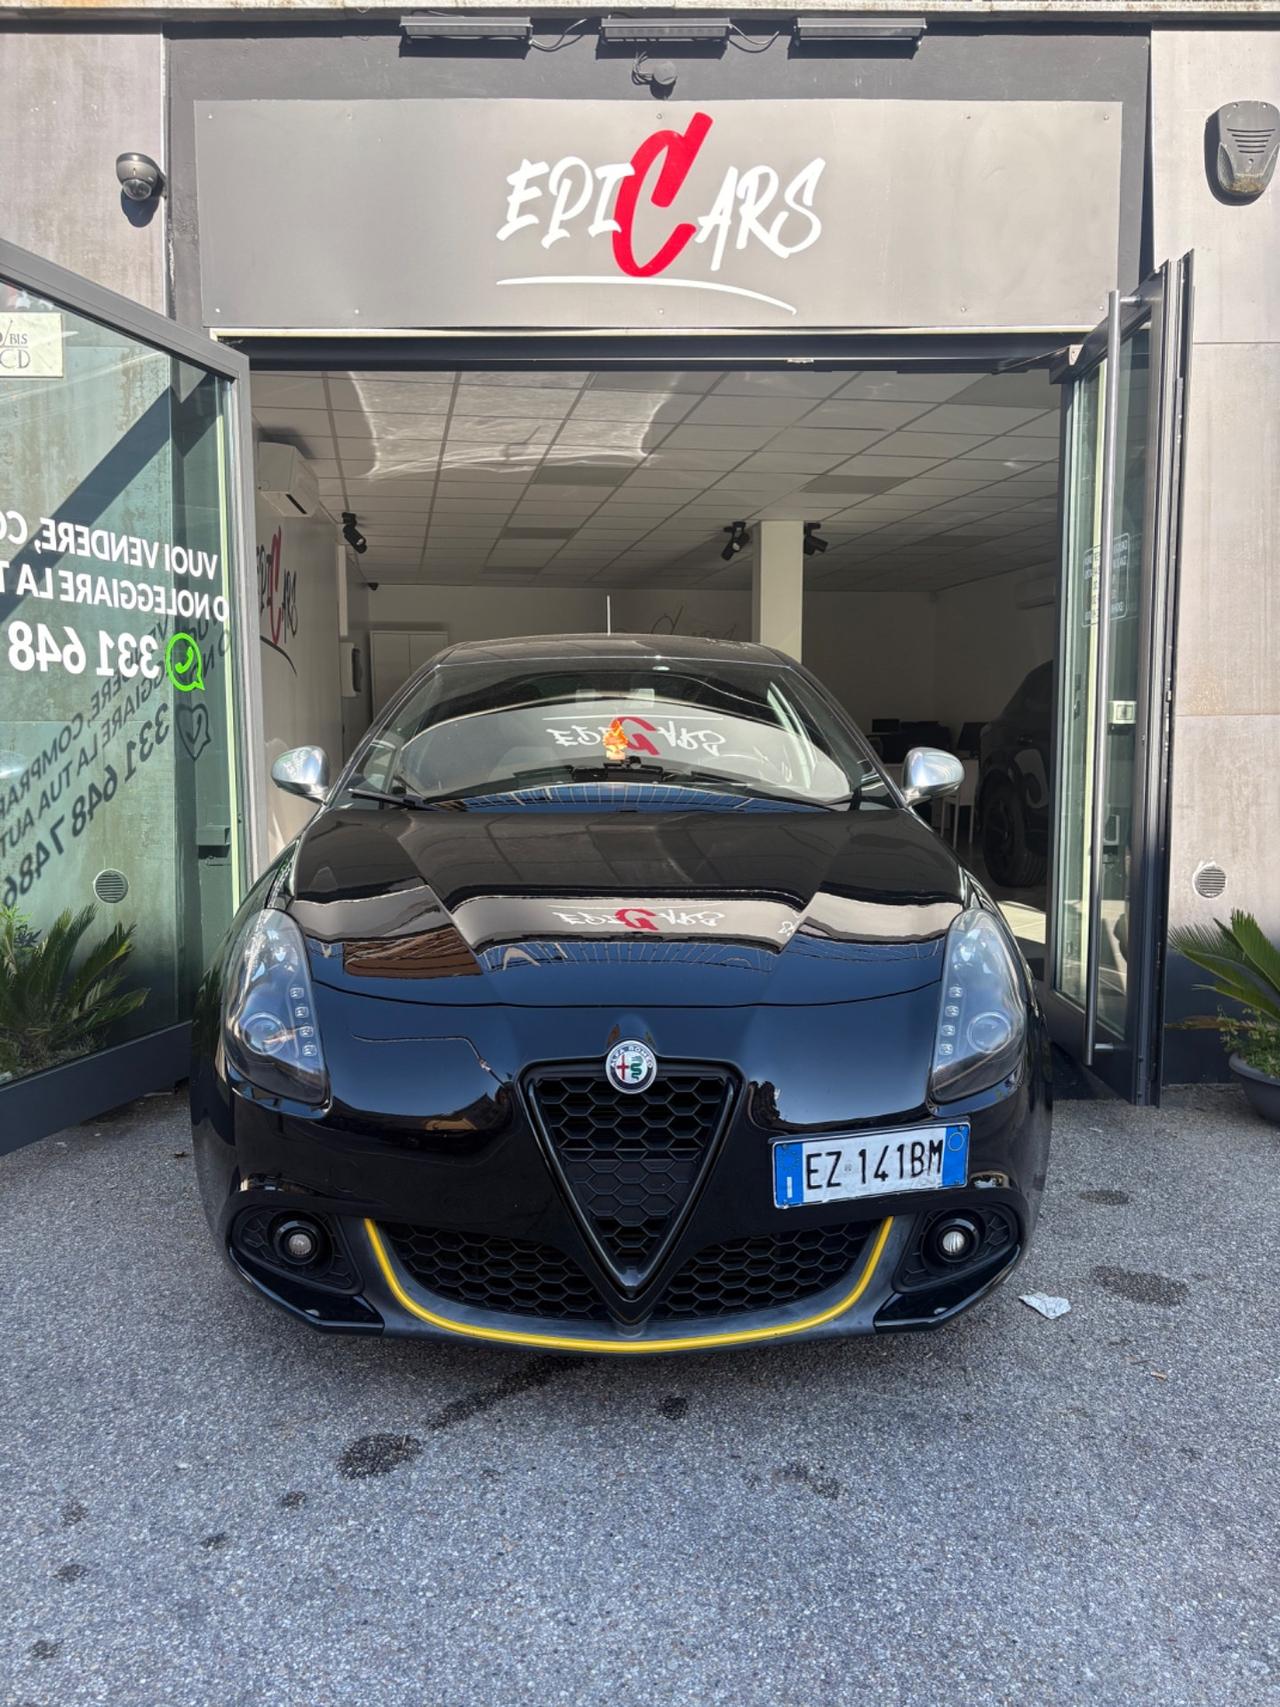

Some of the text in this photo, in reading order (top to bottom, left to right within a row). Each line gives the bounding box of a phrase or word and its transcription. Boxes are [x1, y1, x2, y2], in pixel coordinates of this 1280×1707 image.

[496, 111, 826, 278] EPICARS
[805, 1139, 944, 1190] EZ 141BM
